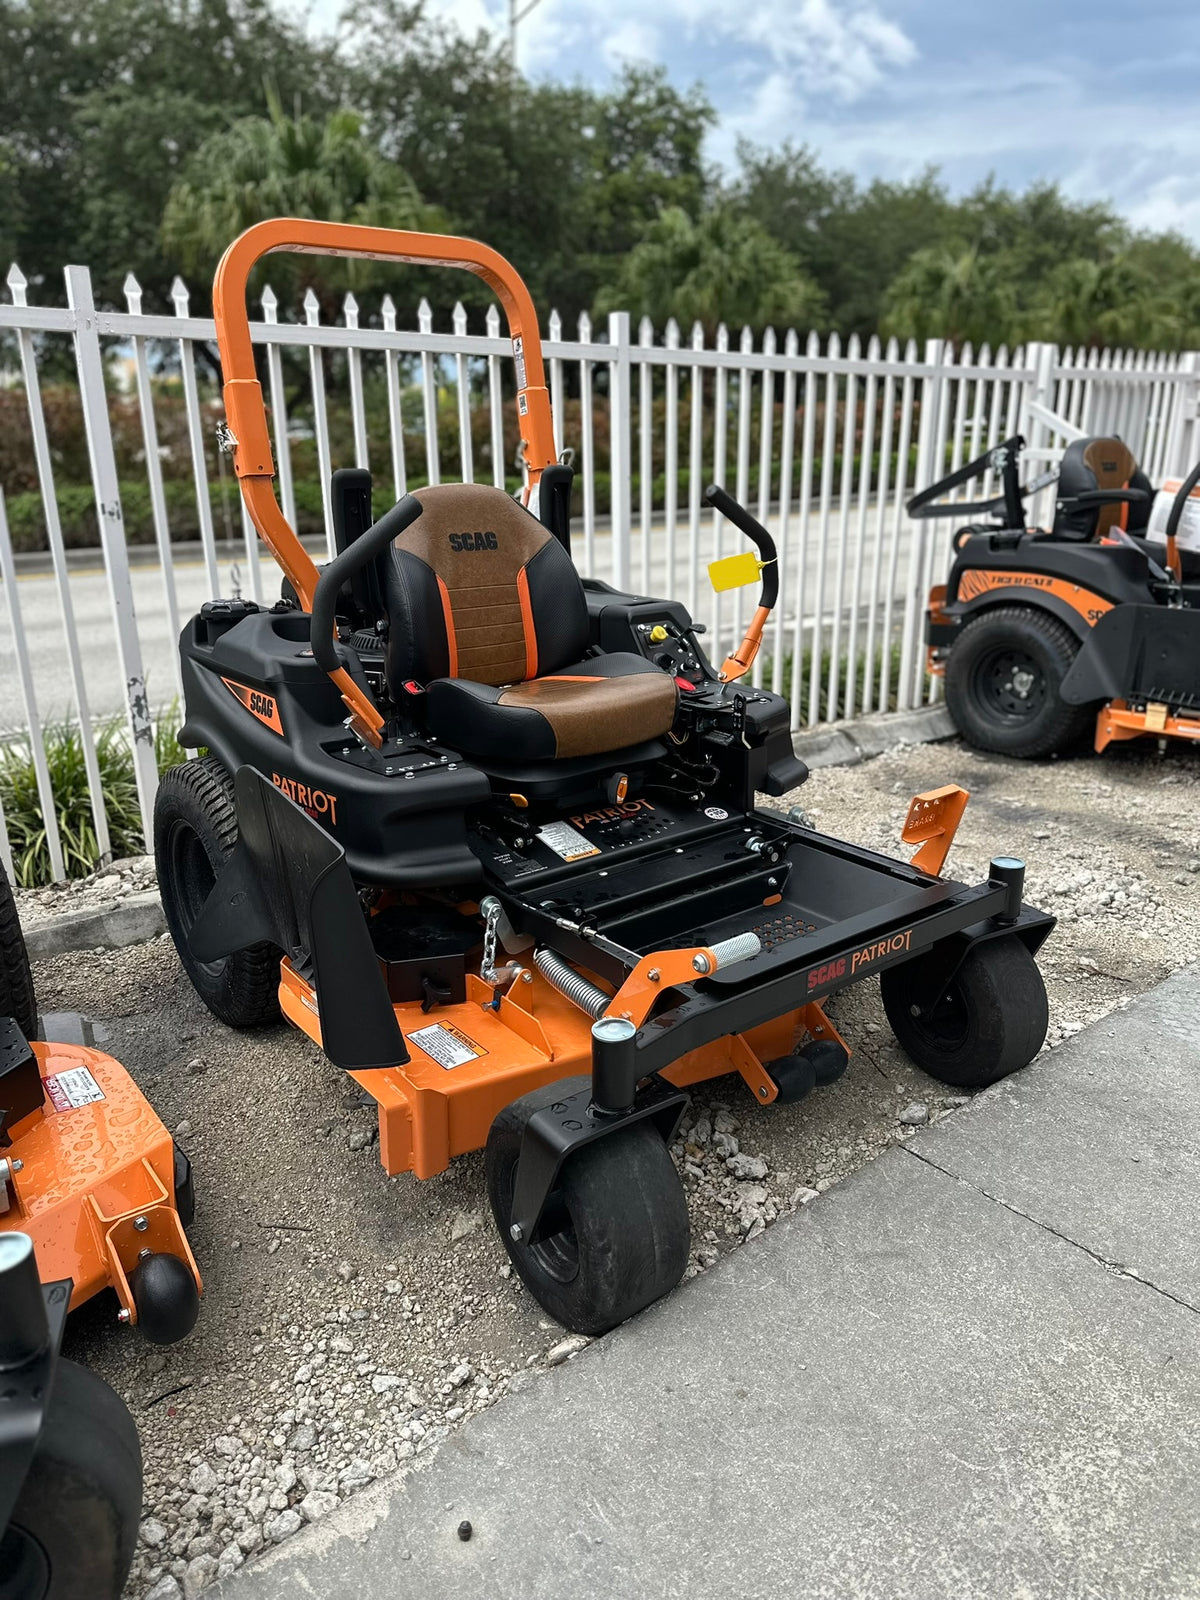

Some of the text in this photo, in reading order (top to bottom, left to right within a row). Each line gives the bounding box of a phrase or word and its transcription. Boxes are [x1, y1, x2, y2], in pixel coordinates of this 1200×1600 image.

[449, 531, 498, 552] SCAG
[1088, 609, 1104, 621] SC
[250, 692, 273, 719] SCAG
[272, 773, 337, 826] PATRIOT
[569, 799, 656, 829] PATRIOT
[807, 929, 913, 989] SCAG PATRIOT
